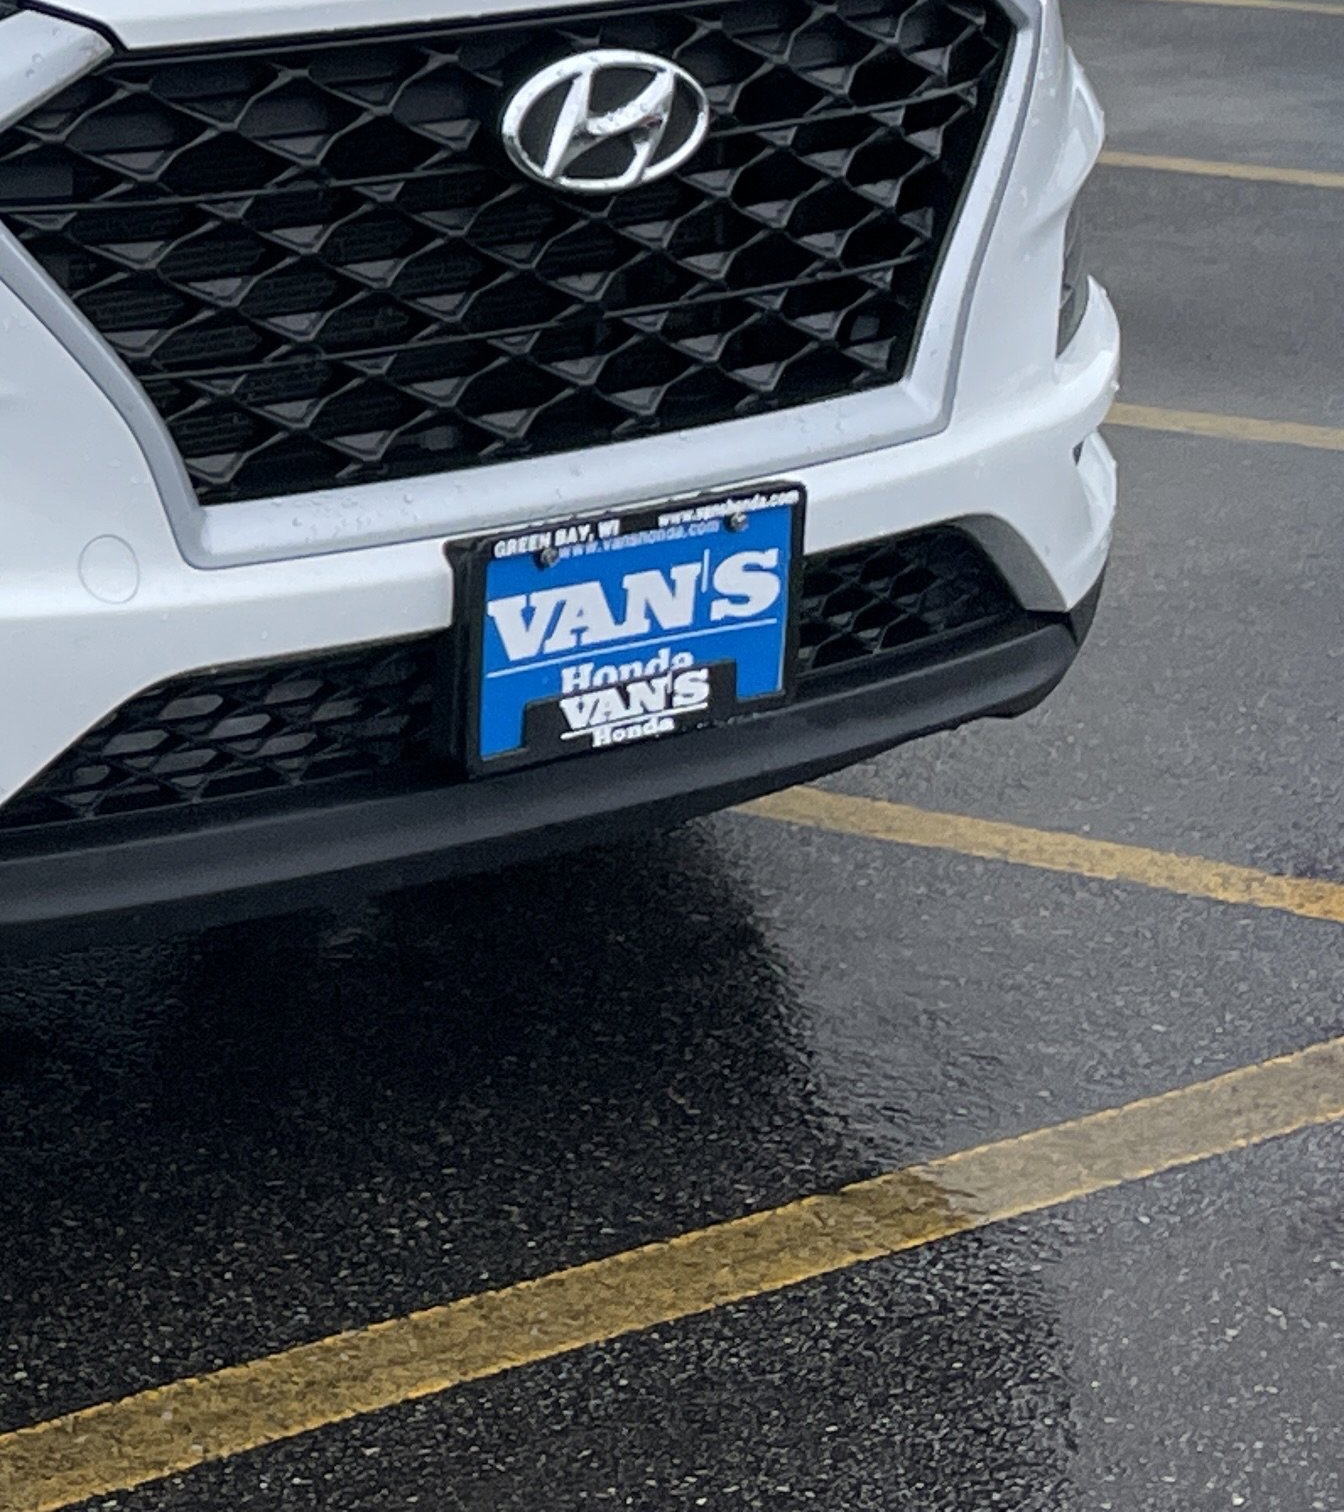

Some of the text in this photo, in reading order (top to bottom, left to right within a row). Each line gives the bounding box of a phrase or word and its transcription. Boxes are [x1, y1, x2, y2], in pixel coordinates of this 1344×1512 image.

[494, 531, 552, 559] GREEN
[597, 518, 621, 539] WI
[487, 548, 781, 662] VAN'S
[561, 647, 695, 695] Honda
[559, 668, 710, 731] VAN'S
[592, 716, 675, 749] Honda
